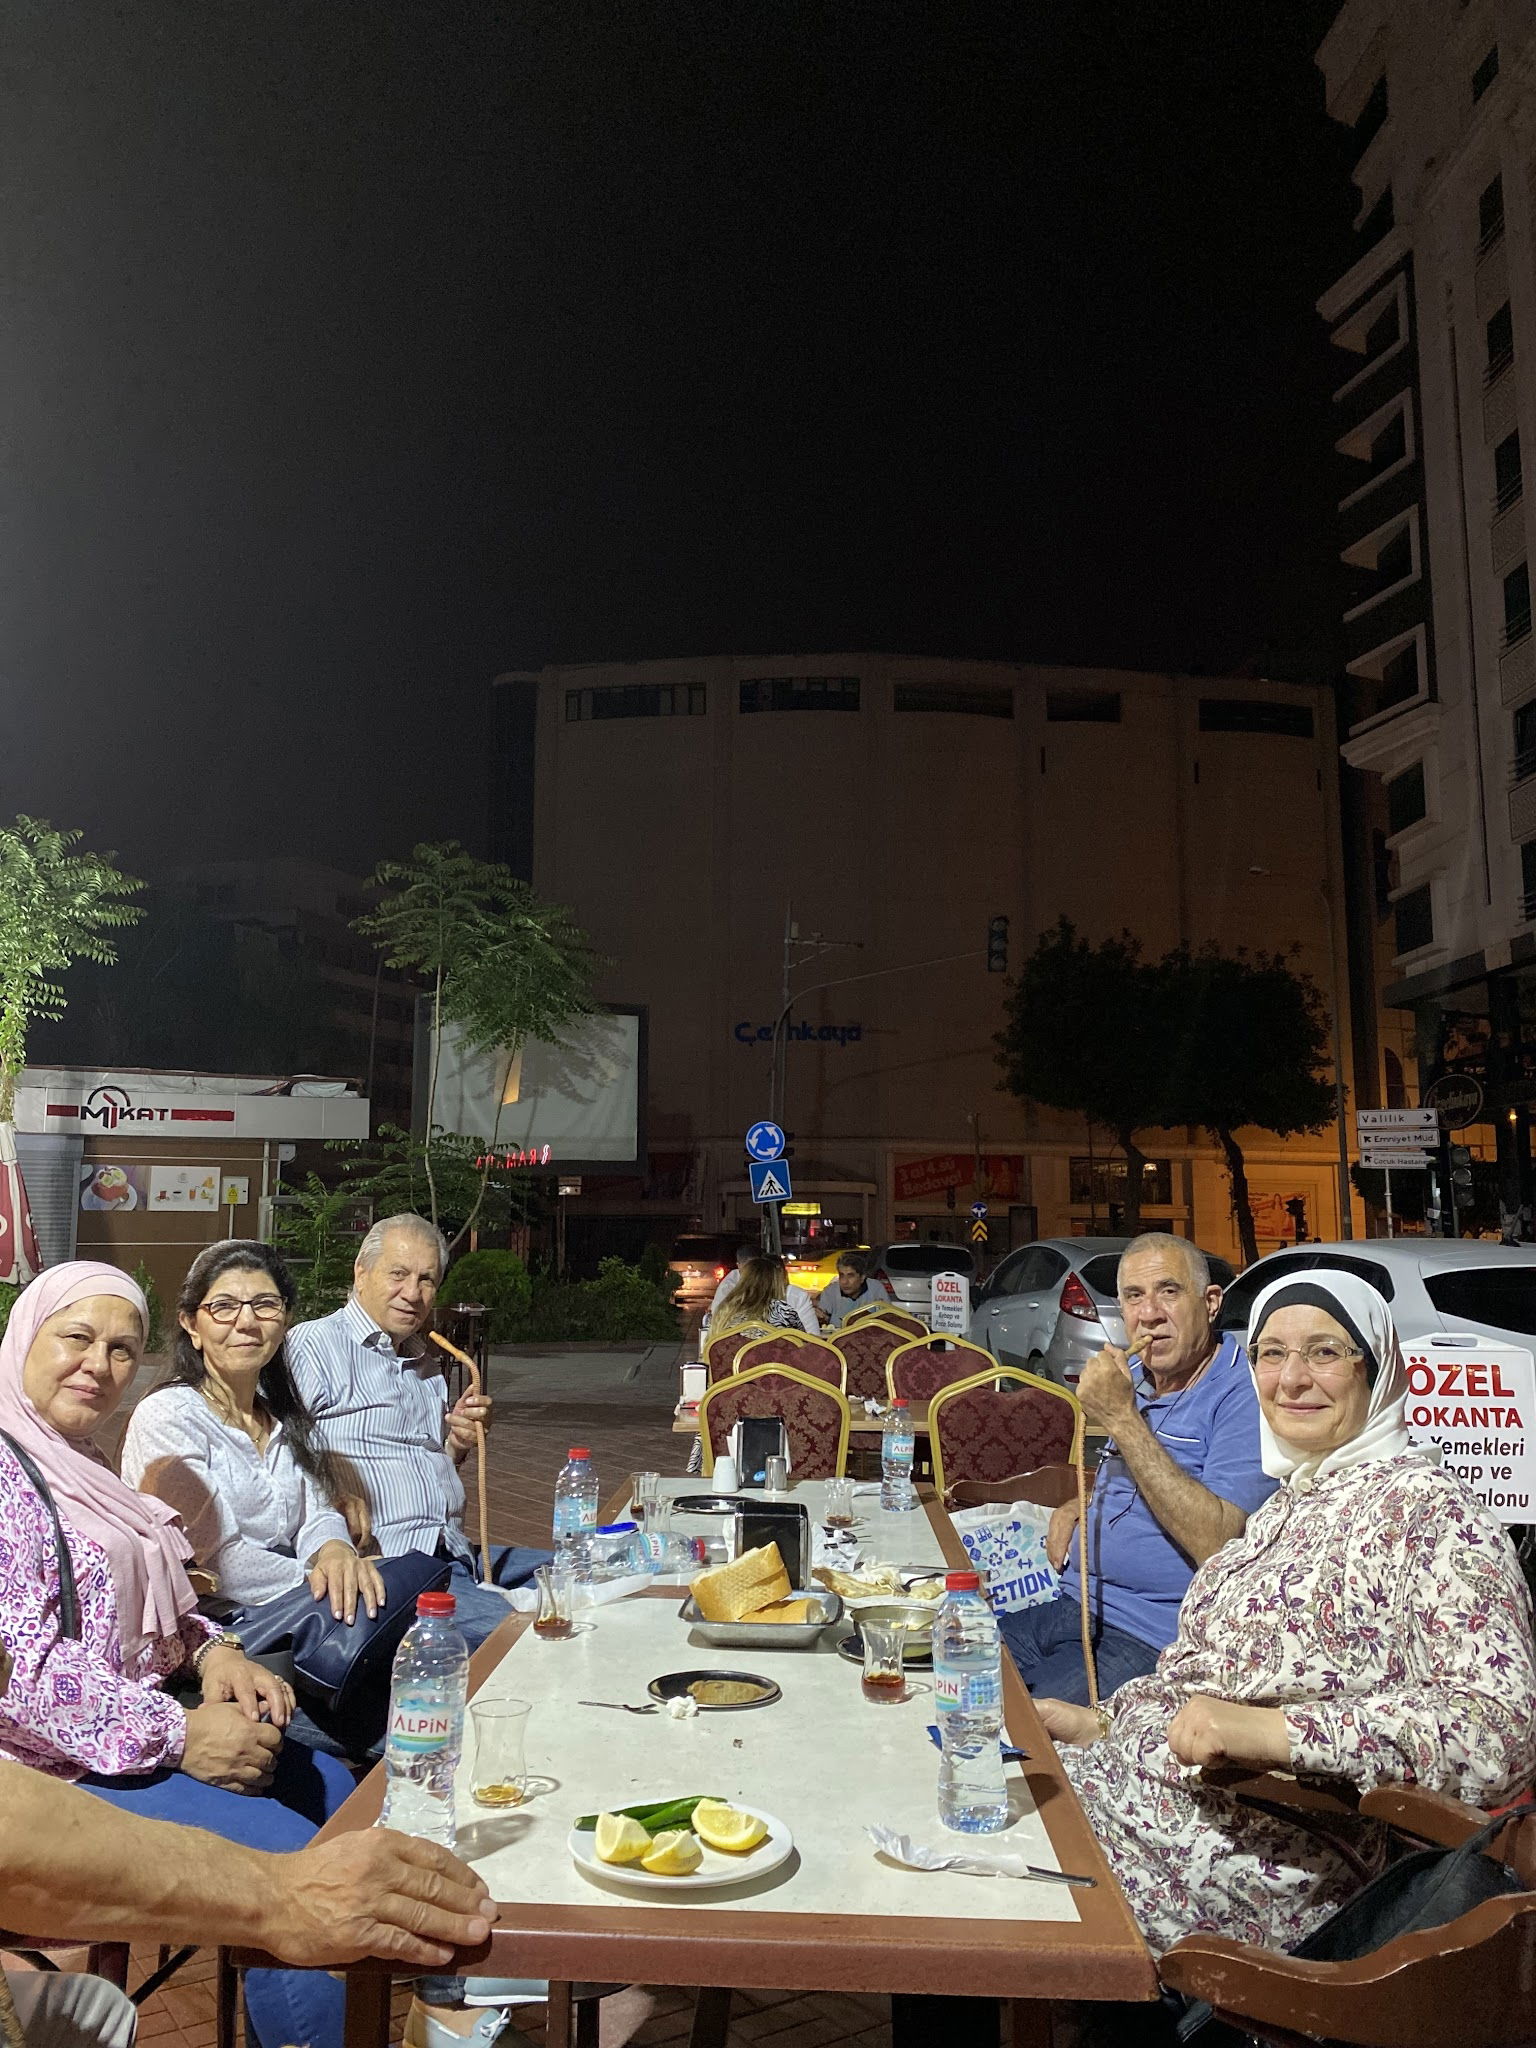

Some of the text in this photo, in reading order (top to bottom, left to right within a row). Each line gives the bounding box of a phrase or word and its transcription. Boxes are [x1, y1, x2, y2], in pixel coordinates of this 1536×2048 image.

[734, 1021, 863, 1047] Çenkaya
[1362, 1114, 1405, 1123] Valilik
[1374, 1135, 1411, 1144] Emniyet
[937, 1279, 961, 1293] ÖZEL
[935, 1295, 963, 1303] LOKANTA
[1404, 1356, 1516, 1398] ÖZEL
[1490, 1466, 1513, 1480] ve
[986, 1568, 1054, 1605] CTION
